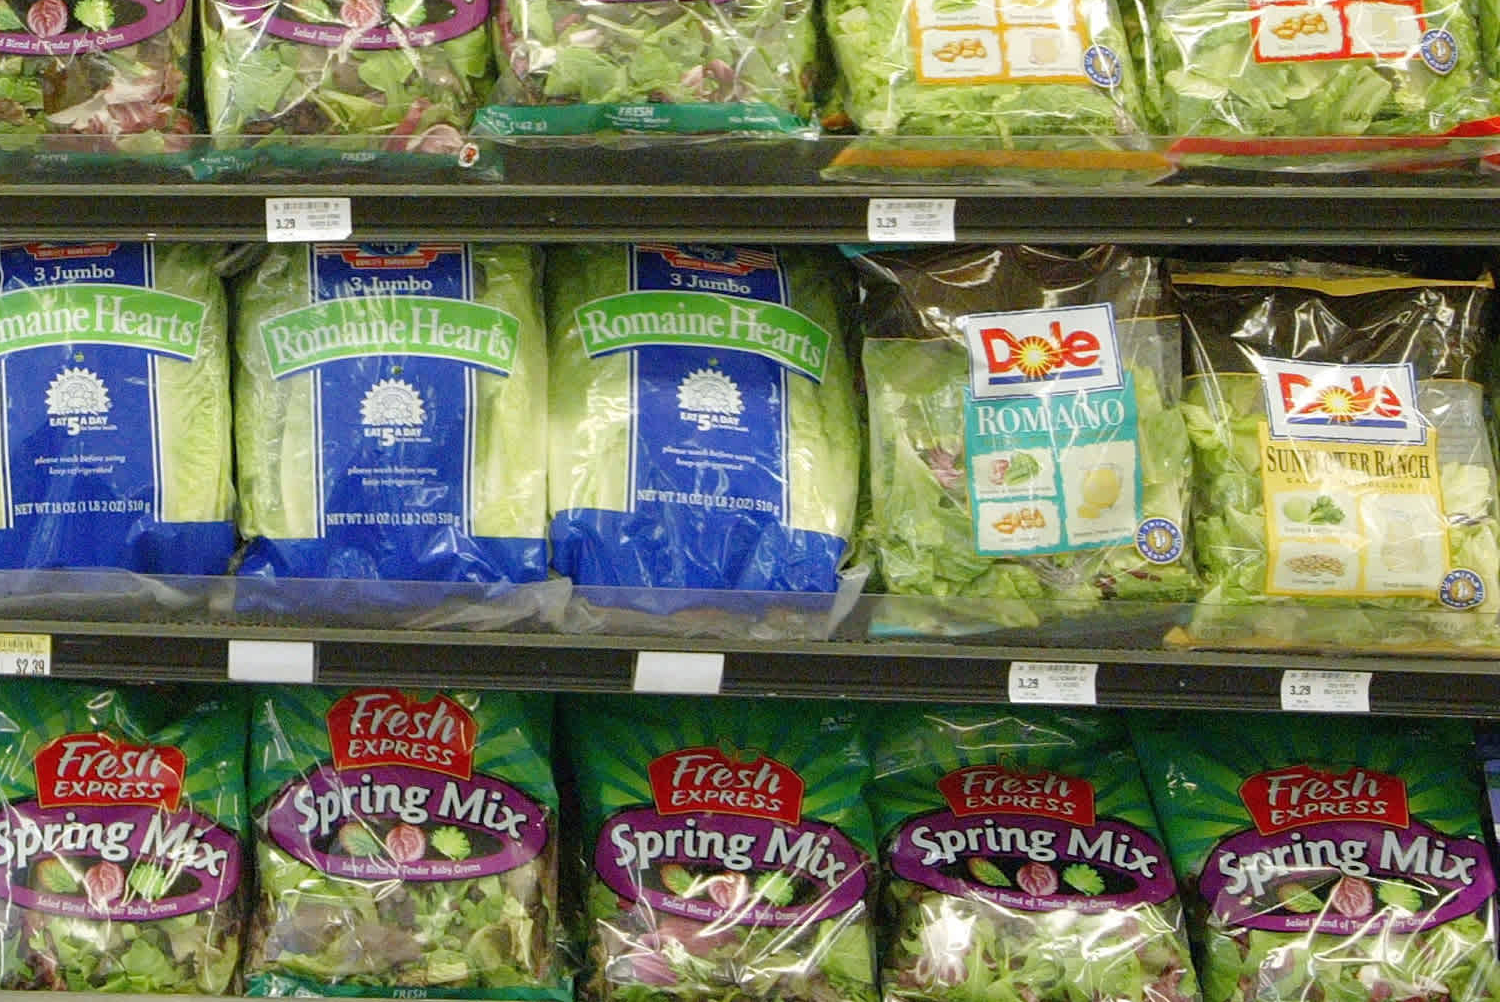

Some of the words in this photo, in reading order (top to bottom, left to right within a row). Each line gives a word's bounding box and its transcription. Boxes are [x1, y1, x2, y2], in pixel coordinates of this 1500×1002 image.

[34, 266, 45, 281] 3
[50, 264, 115, 281] Jumbo
[351, 276, 361, 291] 3
[369, 277, 432, 293] Jumbo
[670, 273, 681, 287] 3
[686, 274, 751, 294] Jumbo
[95, 293, 194, 346] Hearts
[271, 311, 407, 364] Romaine
[412, 306, 513, 362] Hearts
[585, 302, 726, 346] Romaine
[727, 305, 822, 370] Hearts
[67, 417, 80, 435] 5
[976, 397, 1126, 436] ROMANO
[1374, 452, 1432, 479] RANCH
[15, 503, 33, 516] NET
[349, 693, 456, 743] Fresh
[55, 741, 162, 781] Fresh
[347, 738, 455, 767] EXPRESS
[53, 781, 165, 801] EXPRESS
[672, 755, 784, 796] Fresh
[961, 770, 1075, 798] Fresh
[1267, 771, 1380, 807] Fresh
[294, 773, 430, 833] Spring
[439, 781, 529, 842] Mix
[670, 790, 782, 813] EXPRESS
[965, 793, 1077, 817] EXPRESS
[1271, 799, 1388, 827] EXPRESS
[140, 820, 229, 878] Mix
[611, 818, 757, 872] Spring
[763, 826, 847, 888] Mix
[911, 819, 1056, 866] Spring
[1067, 827, 1160, 879] Mix
[1219, 834, 1367, 897] Spring
[1380, 830, 1476, 886] Mix
